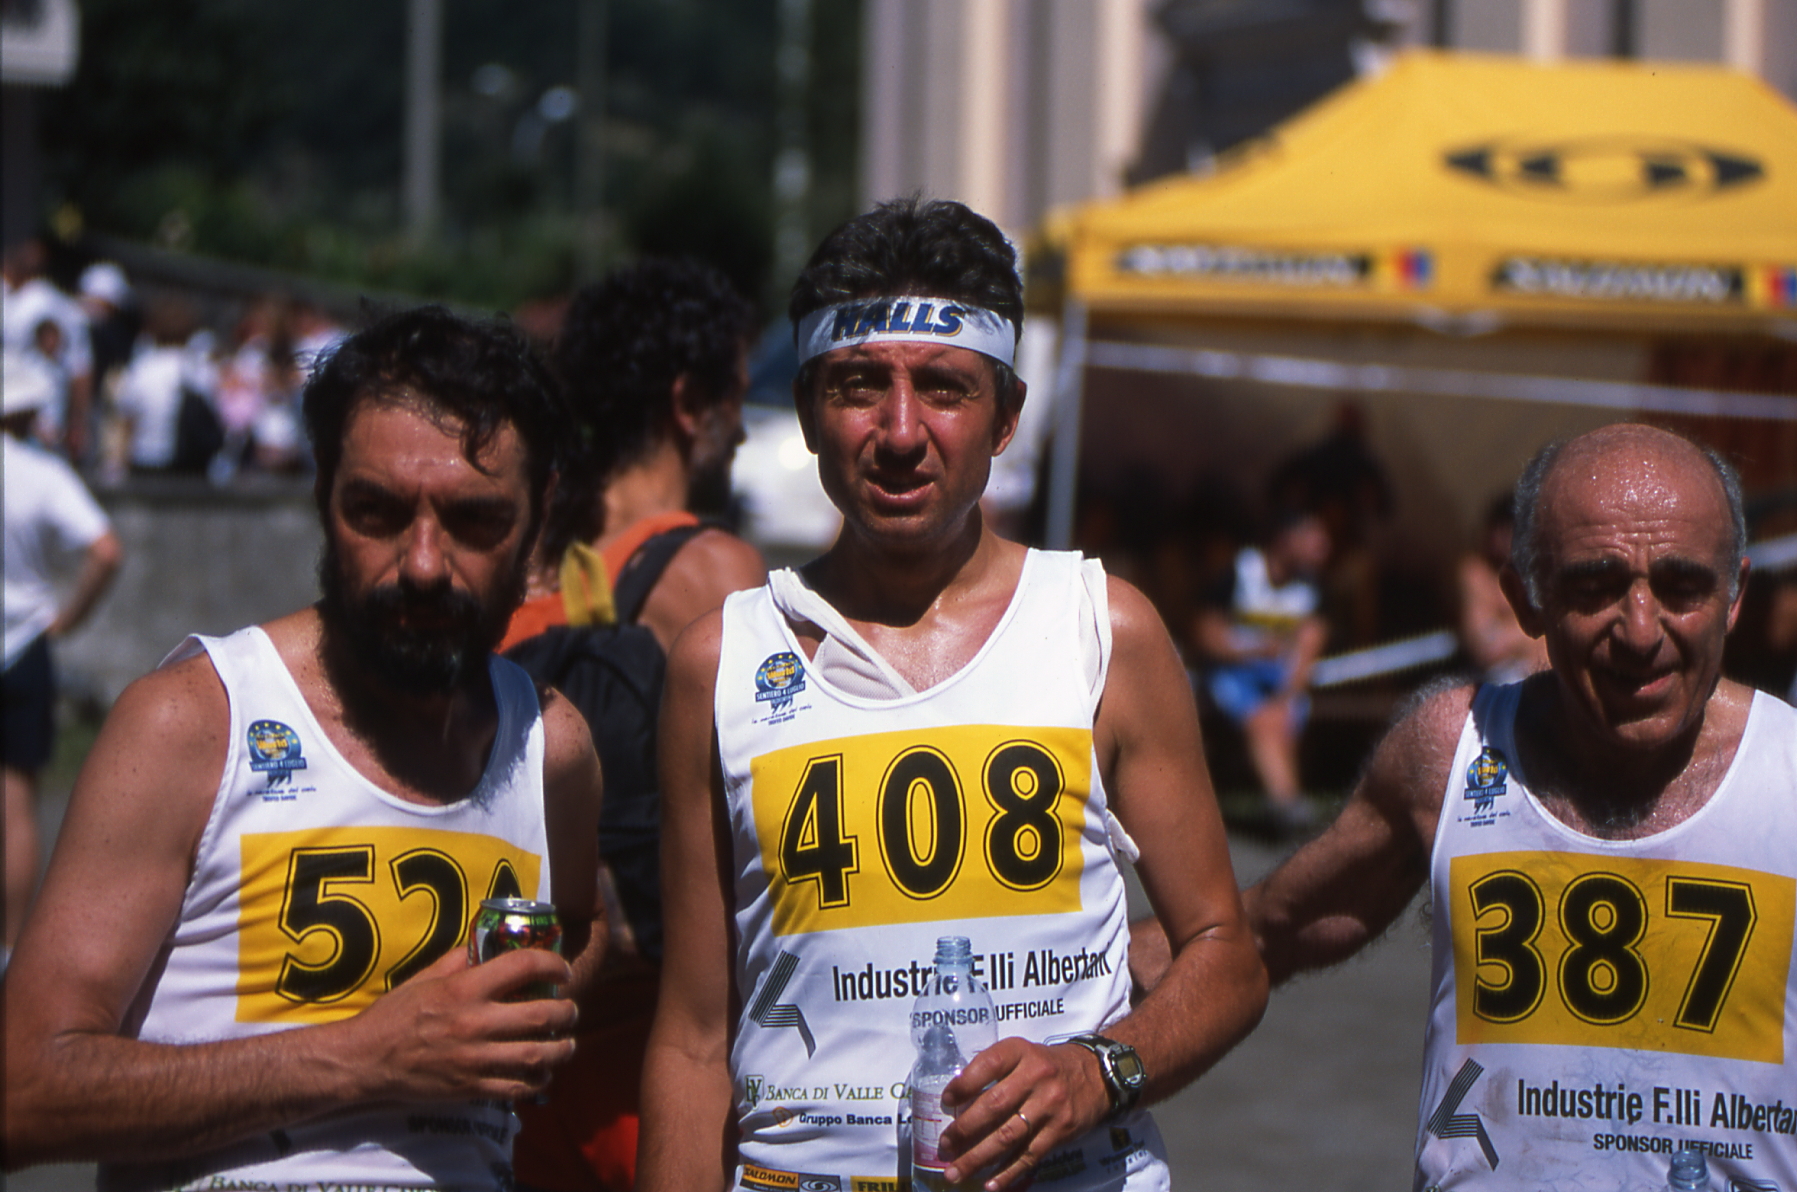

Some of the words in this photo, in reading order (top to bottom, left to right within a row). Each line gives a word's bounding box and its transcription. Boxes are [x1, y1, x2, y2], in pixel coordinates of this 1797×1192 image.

[831, 301, 966, 341] HALLS
[778, 739, 1065, 910] 408
[1468, 868, 1758, 1034] 387
[911, 1007, 989, 1029] SPONSOR
[995, 997, 1064, 1022] UFFICIALE
[765, 1085, 808, 1101] BANCA
[813, 1087, 829, 1100] DI
[834, 1083, 884, 1100] VALLE
[1518, 1079, 1643, 1123] Industrie
[1653, 1086, 1701, 1126] F.lli
[799, 1113, 842, 1127] Gruppo
[846, 1113, 892, 1125] Banca
[1594, 1134, 1673, 1154] SPONSOR
[745, 1167, 796, 1185] SALOMON
